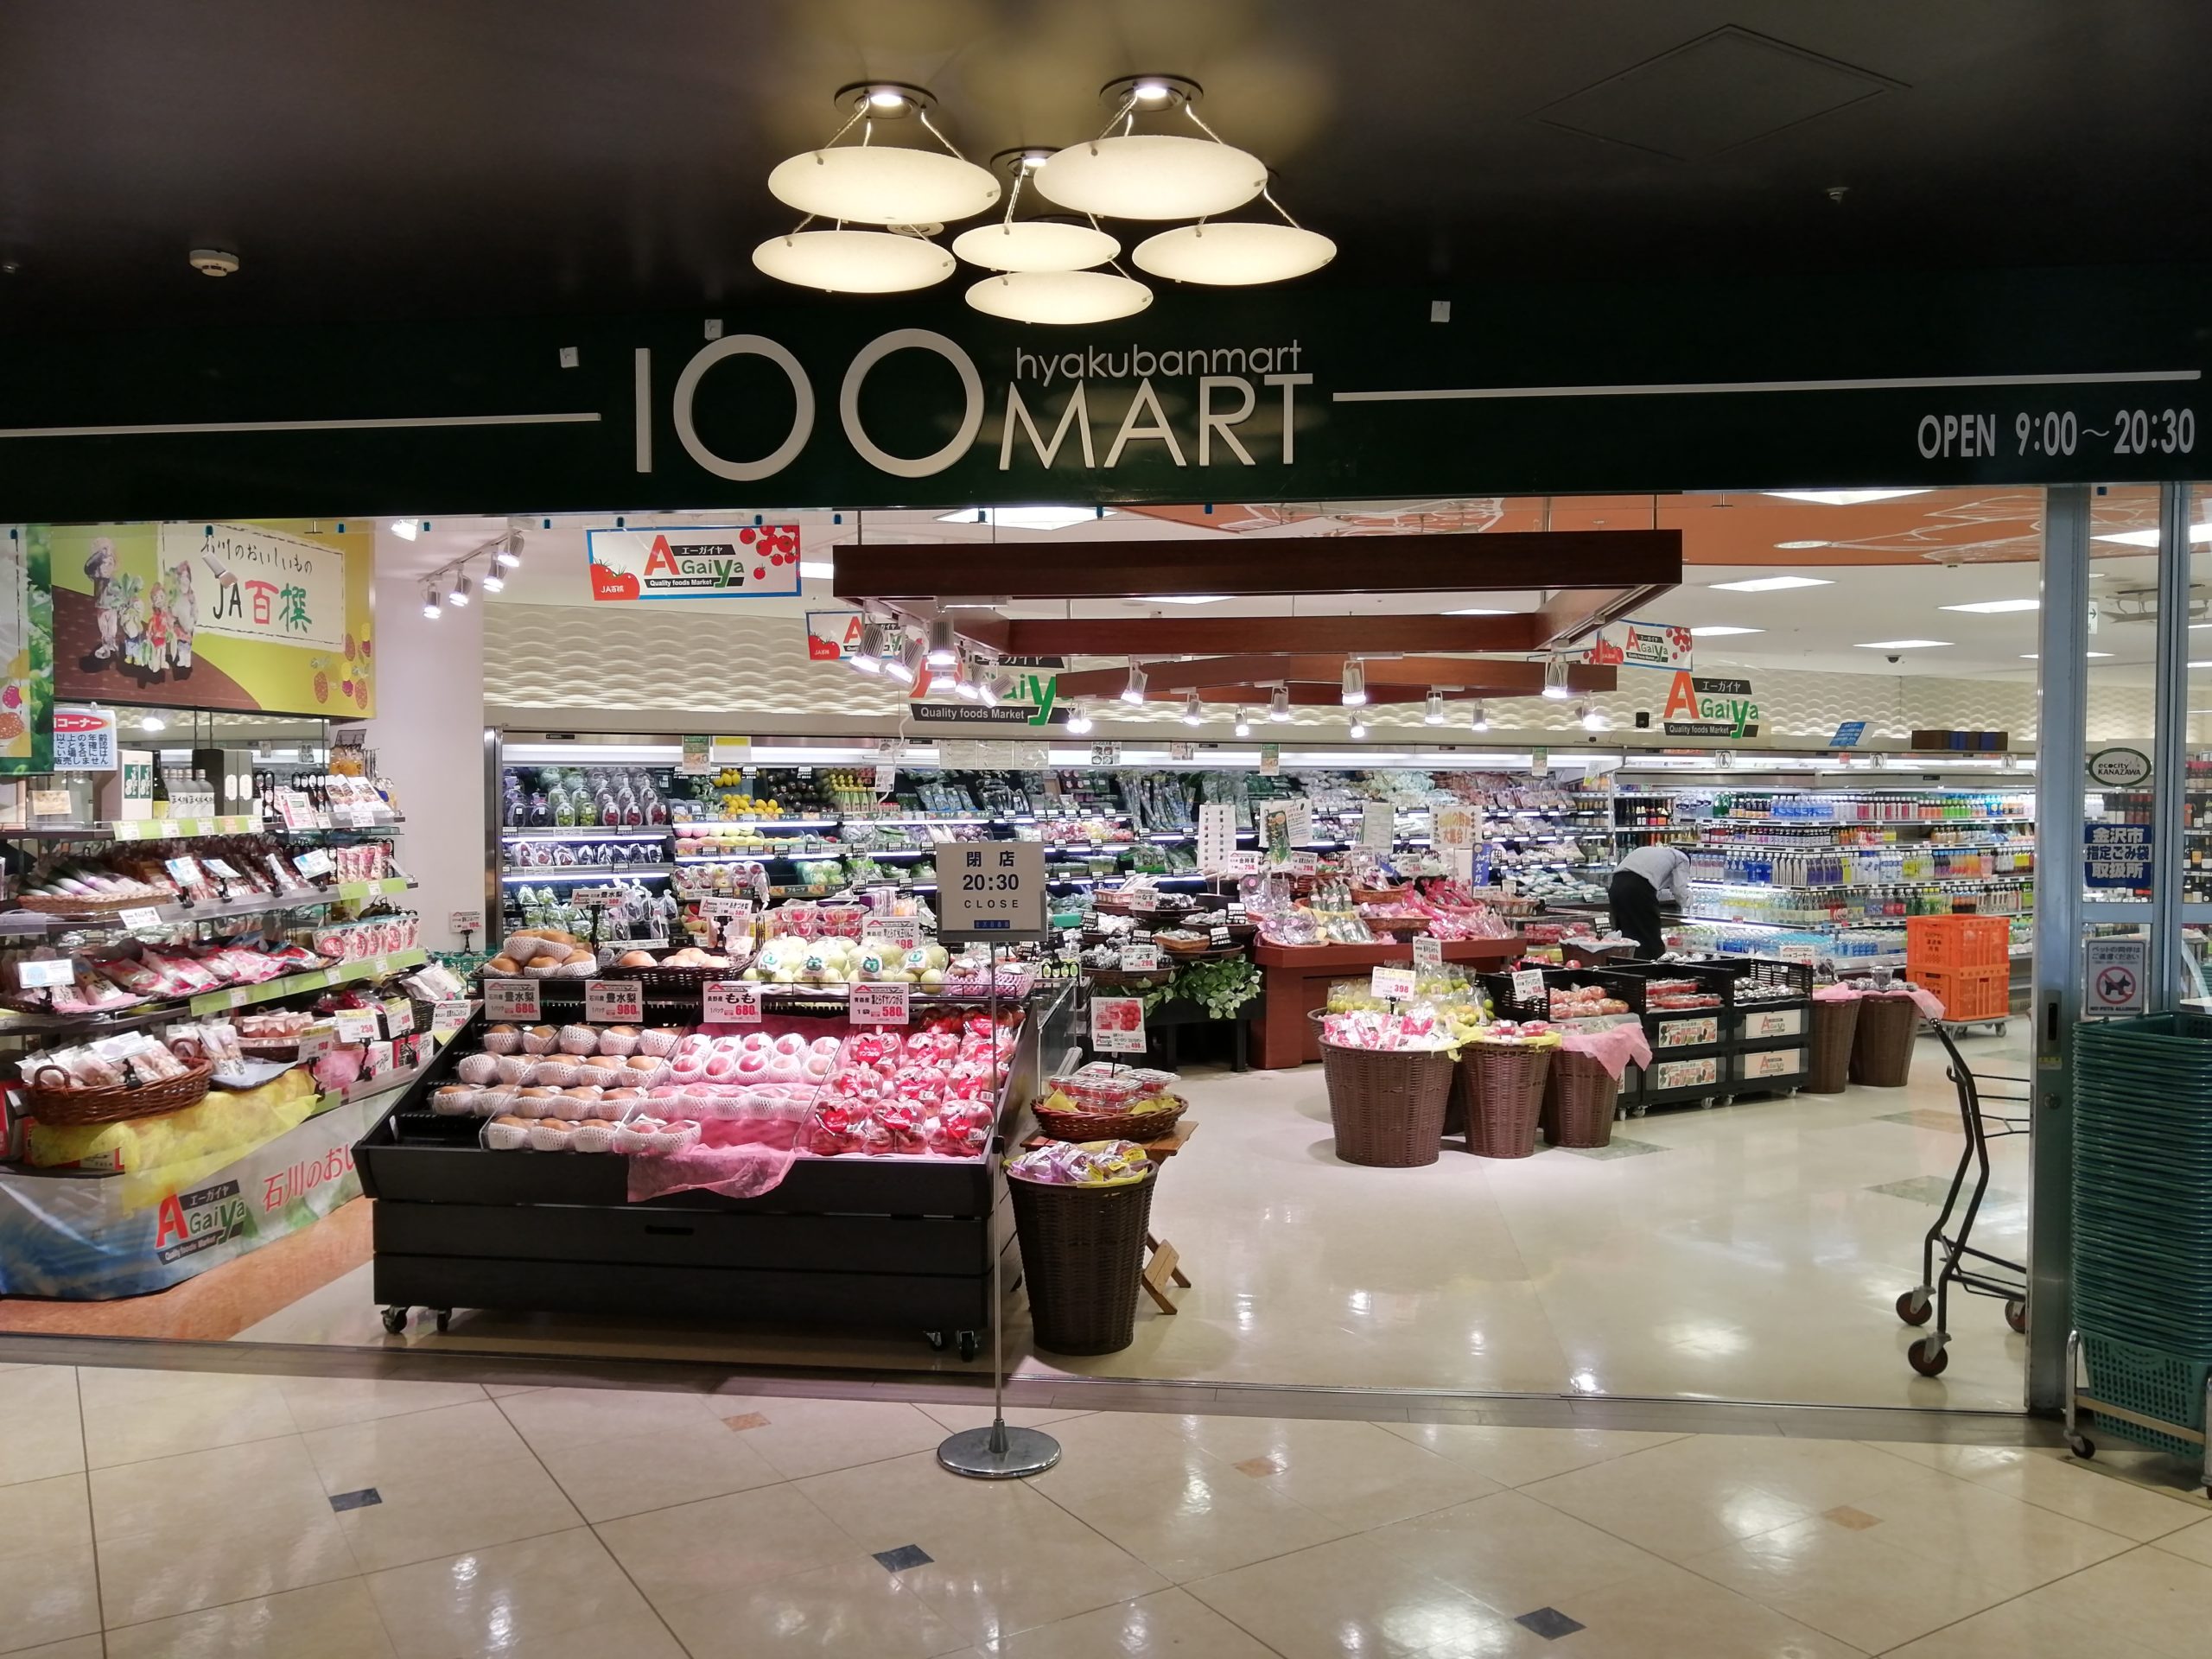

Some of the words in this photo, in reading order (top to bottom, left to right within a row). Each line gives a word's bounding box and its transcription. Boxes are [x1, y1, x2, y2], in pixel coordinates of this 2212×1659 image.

[1017, 340, 1301, 387] hyakubanmart
[999, 373, 1313, 470] MART
[1917, 414, 1996, 459] OPEN
[681, 546, 723, 556] エーガイヤ
[1701, 681, 1741, 692] エーガイヤ
[920, 707, 957, 720] Quality
[960, 708, 988, 719] foods
[991, 709, 1025, 720] Market
[1669, 725, 1690, 735] Quality
[2092, 827, 2145, 843] 金沢市
[2087, 845, 2149, 861] 指定ごみ袋
[2091, 862, 2144, 879] 取扱所
[963, 874, 1020, 891] 20:30
[963, 899, 1019, 909] CLOSE
[1395, 984, 1409, 994] 398
[726, 993, 756, 1004] もも
[617, 1004, 637, 1014] 980
[735, 1005, 755, 1016] 680
[882, 1006, 903, 1017] 580
[190, 1185, 230, 1206] エーガイヤ
